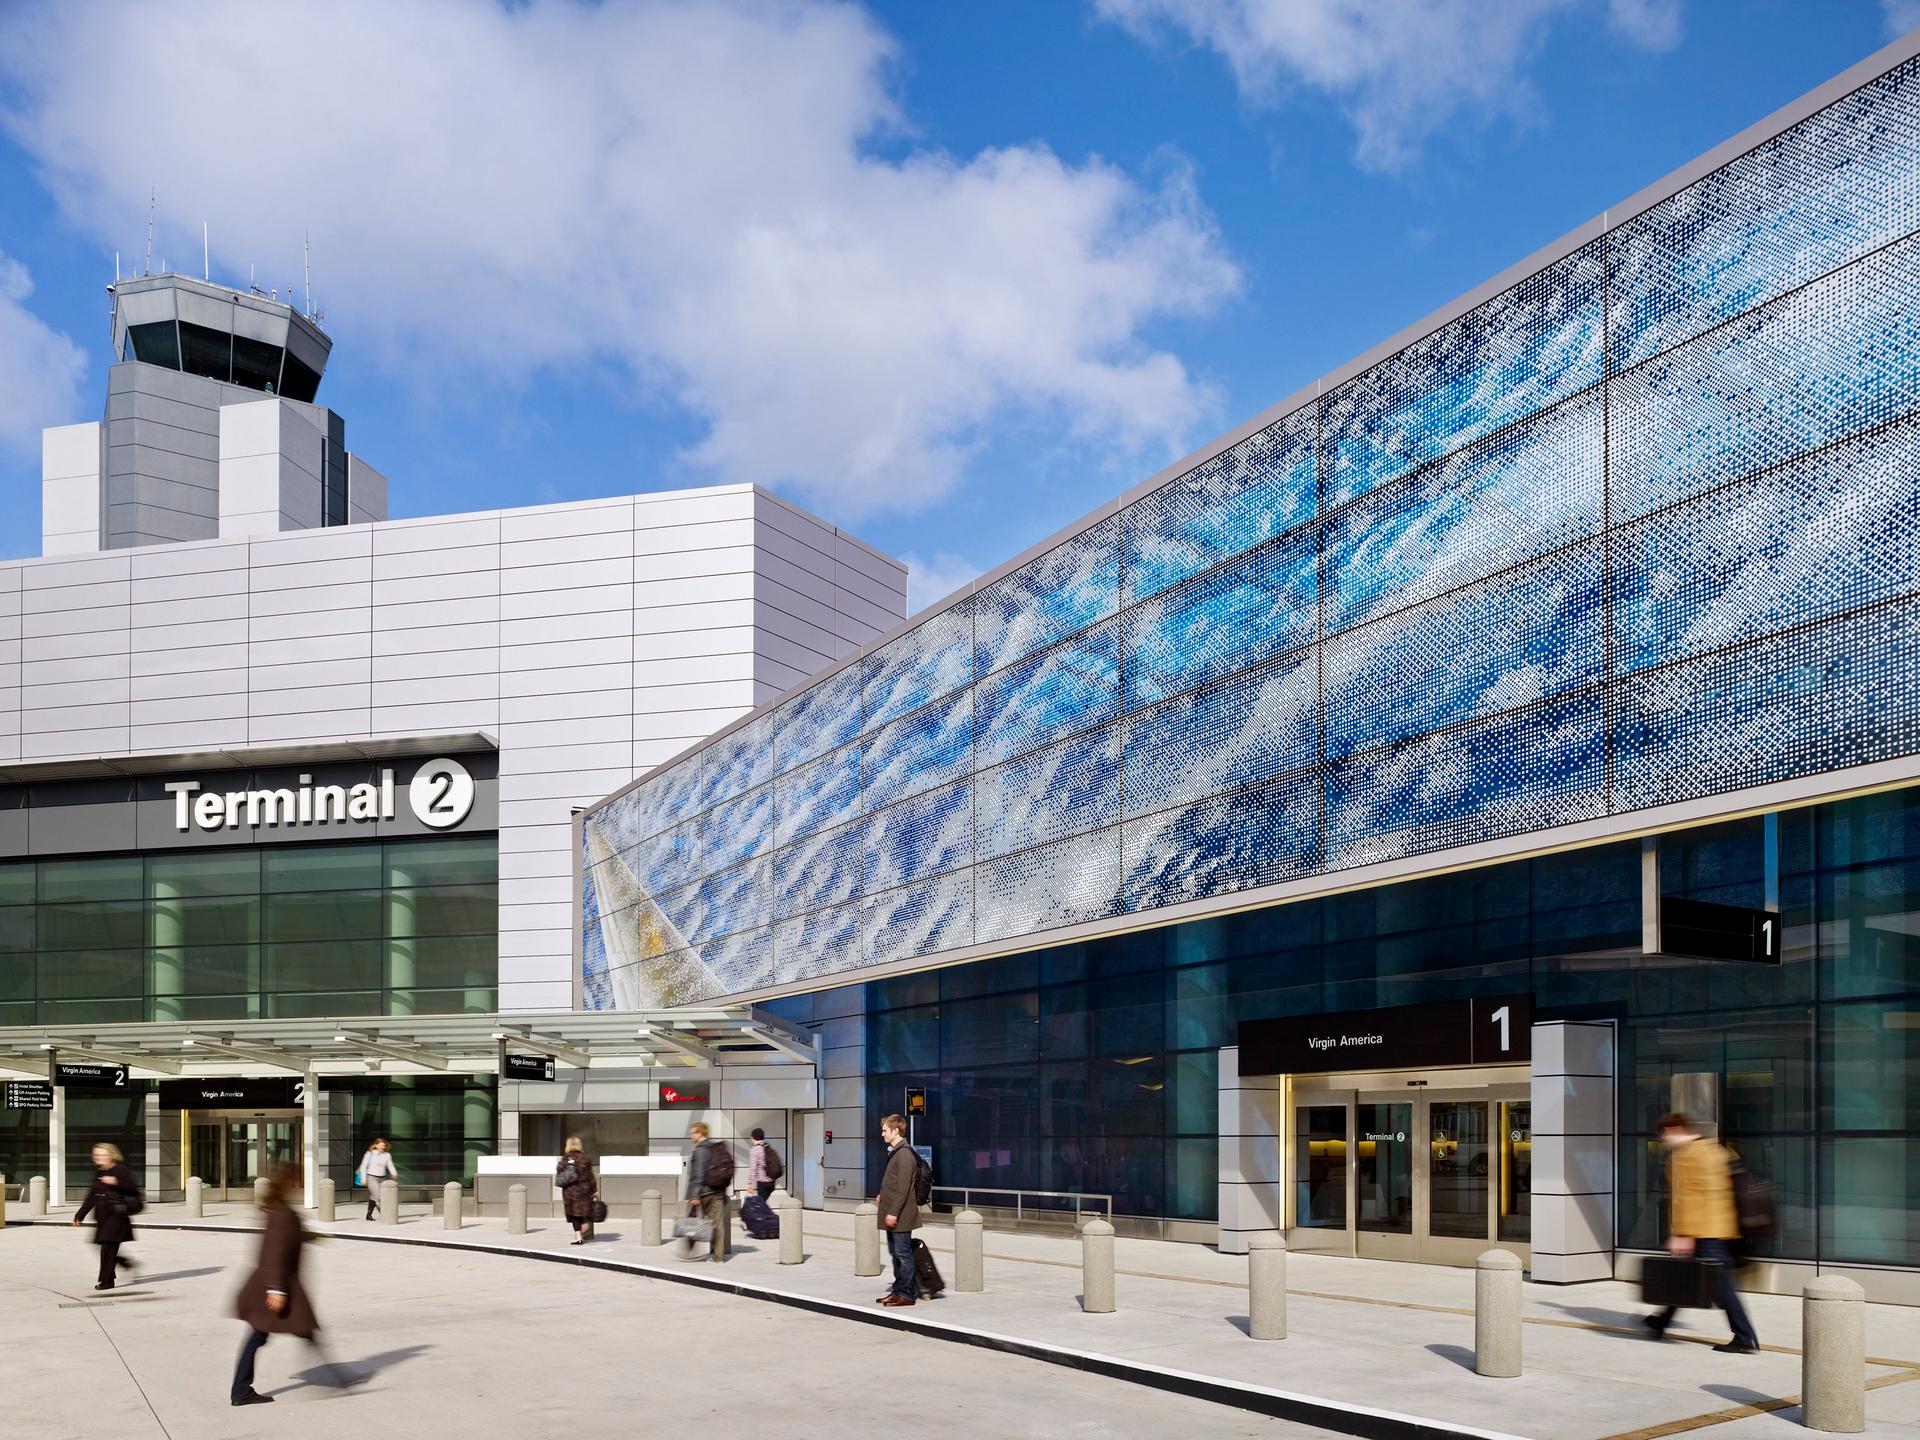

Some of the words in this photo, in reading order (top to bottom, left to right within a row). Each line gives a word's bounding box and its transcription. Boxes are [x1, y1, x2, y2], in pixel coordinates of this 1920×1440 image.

[164, 768, 395, 832] Terminal
[428, 770, 455, 814] 2
[1762, 919, 1772, 956] 1
[1491, 1005, 1510, 1052] 1
[1308, 1036, 1336, 1051] Virgin
[1340, 1034, 1383, 1047] America
[511, 1057, 522, 1066] Virgin
[62, 1066, 78, 1075] Virgin
[79, 1067, 101, 1075] America
[115, 1070, 125, 1086] 2
[201, 1091, 218, 1099] Virgin
[293, 1082, 304, 1104] 2
[1366, 1132, 1395, 1141] Terminal
